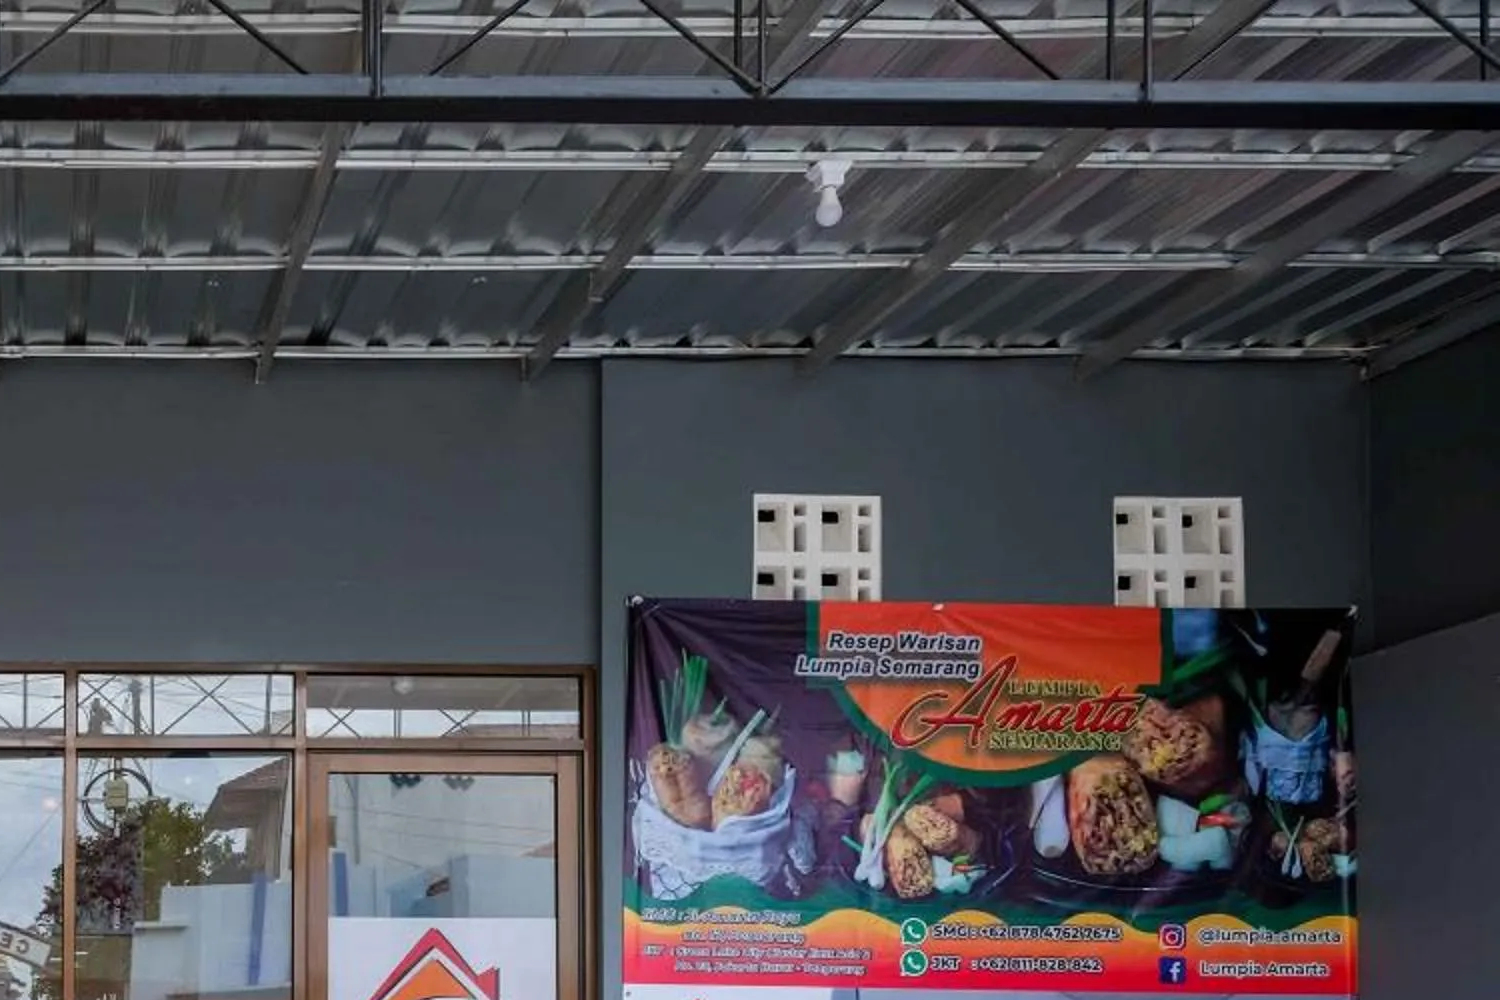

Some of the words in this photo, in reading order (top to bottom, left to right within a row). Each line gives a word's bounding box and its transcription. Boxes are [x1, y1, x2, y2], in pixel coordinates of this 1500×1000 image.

[828, 632, 892, 654] Resep
[897, 634, 982, 653] Warisan
[796, 656, 872, 680] Lumpia
[877, 658, 982, 680] Semarang
[1008, 680, 1102, 697] LUMPIA
[890, 655, 1147, 748] Amarta
[989, 733, 1121, 751] SEMARANG
[933, 924, 967, 938] SMG
[932, 957, 959, 970] JKT
[1201, 961, 1262, 978] Lumpia
[1266, 962, 1328, 976] Amarta
